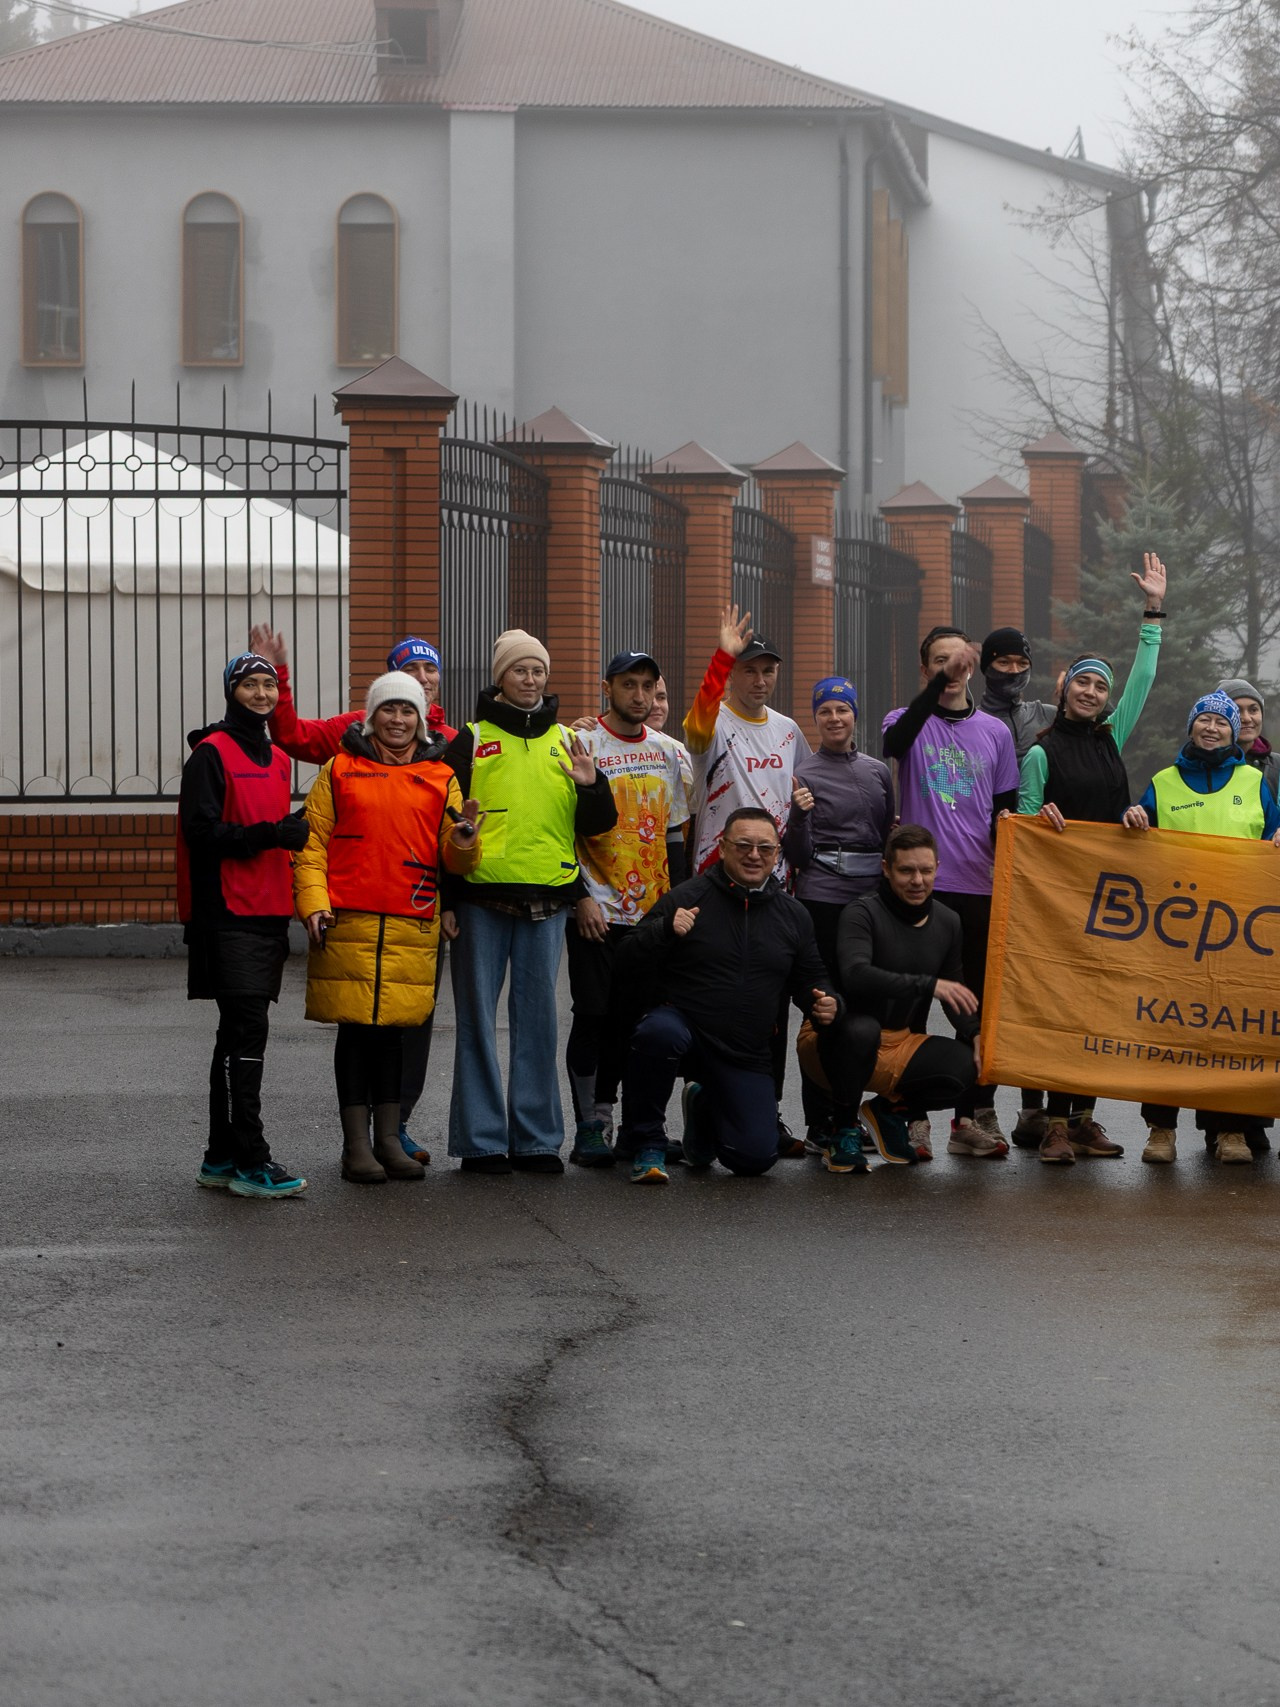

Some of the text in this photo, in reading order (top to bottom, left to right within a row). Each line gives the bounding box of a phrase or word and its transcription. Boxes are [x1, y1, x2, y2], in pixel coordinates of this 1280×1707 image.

[412, 645, 439, 663] ULTRA
[598, 755, 622, 769] БЕЗ
[623, 751, 667, 764] ГРАНИЦ
[604, 764, 667, 776] ЛАГОТВОРИТЕЛЬНЫЙ
[1171, 800, 1205, 812] Волонтёр
[1083, 1035, 1265, 1073] ЦЕНТРАЛЬНЫЙ
